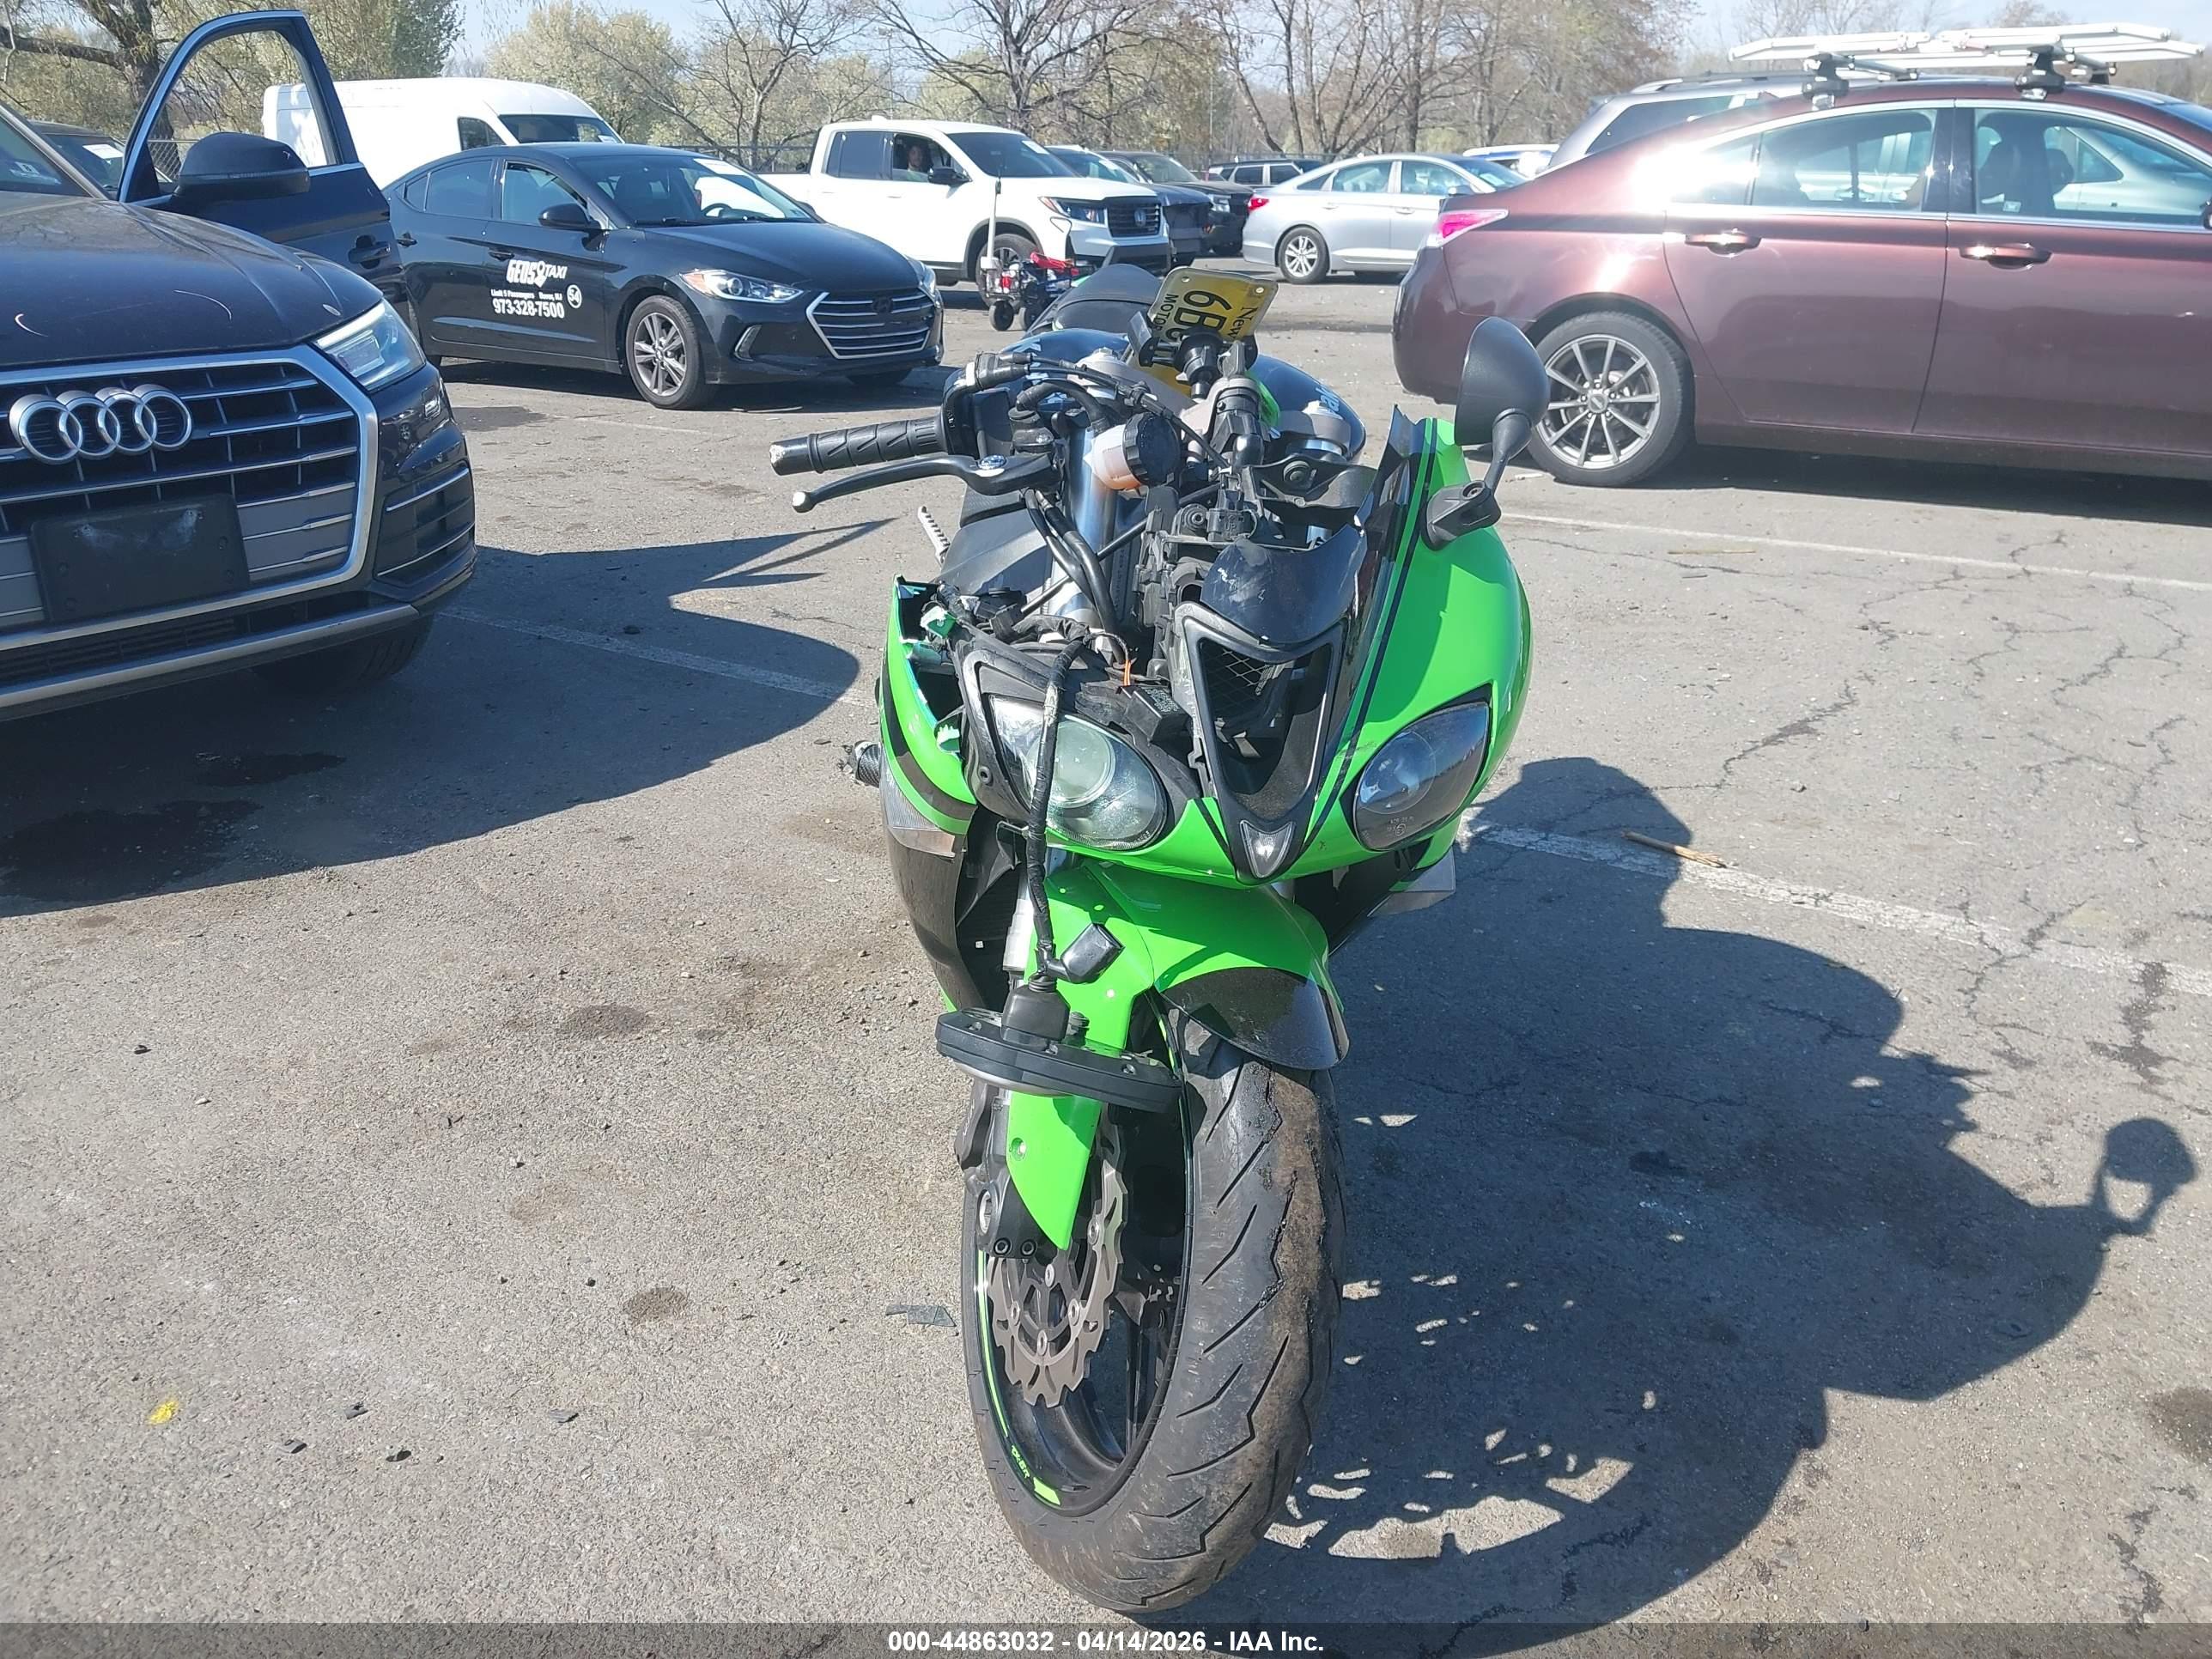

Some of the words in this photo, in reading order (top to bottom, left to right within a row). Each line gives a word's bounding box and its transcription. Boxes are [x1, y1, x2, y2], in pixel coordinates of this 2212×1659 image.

[544, 264, 568, 279] TAXI
[492, 297, 565, 319] 973-328-7500
[1228, 307, 1259, 340] New
